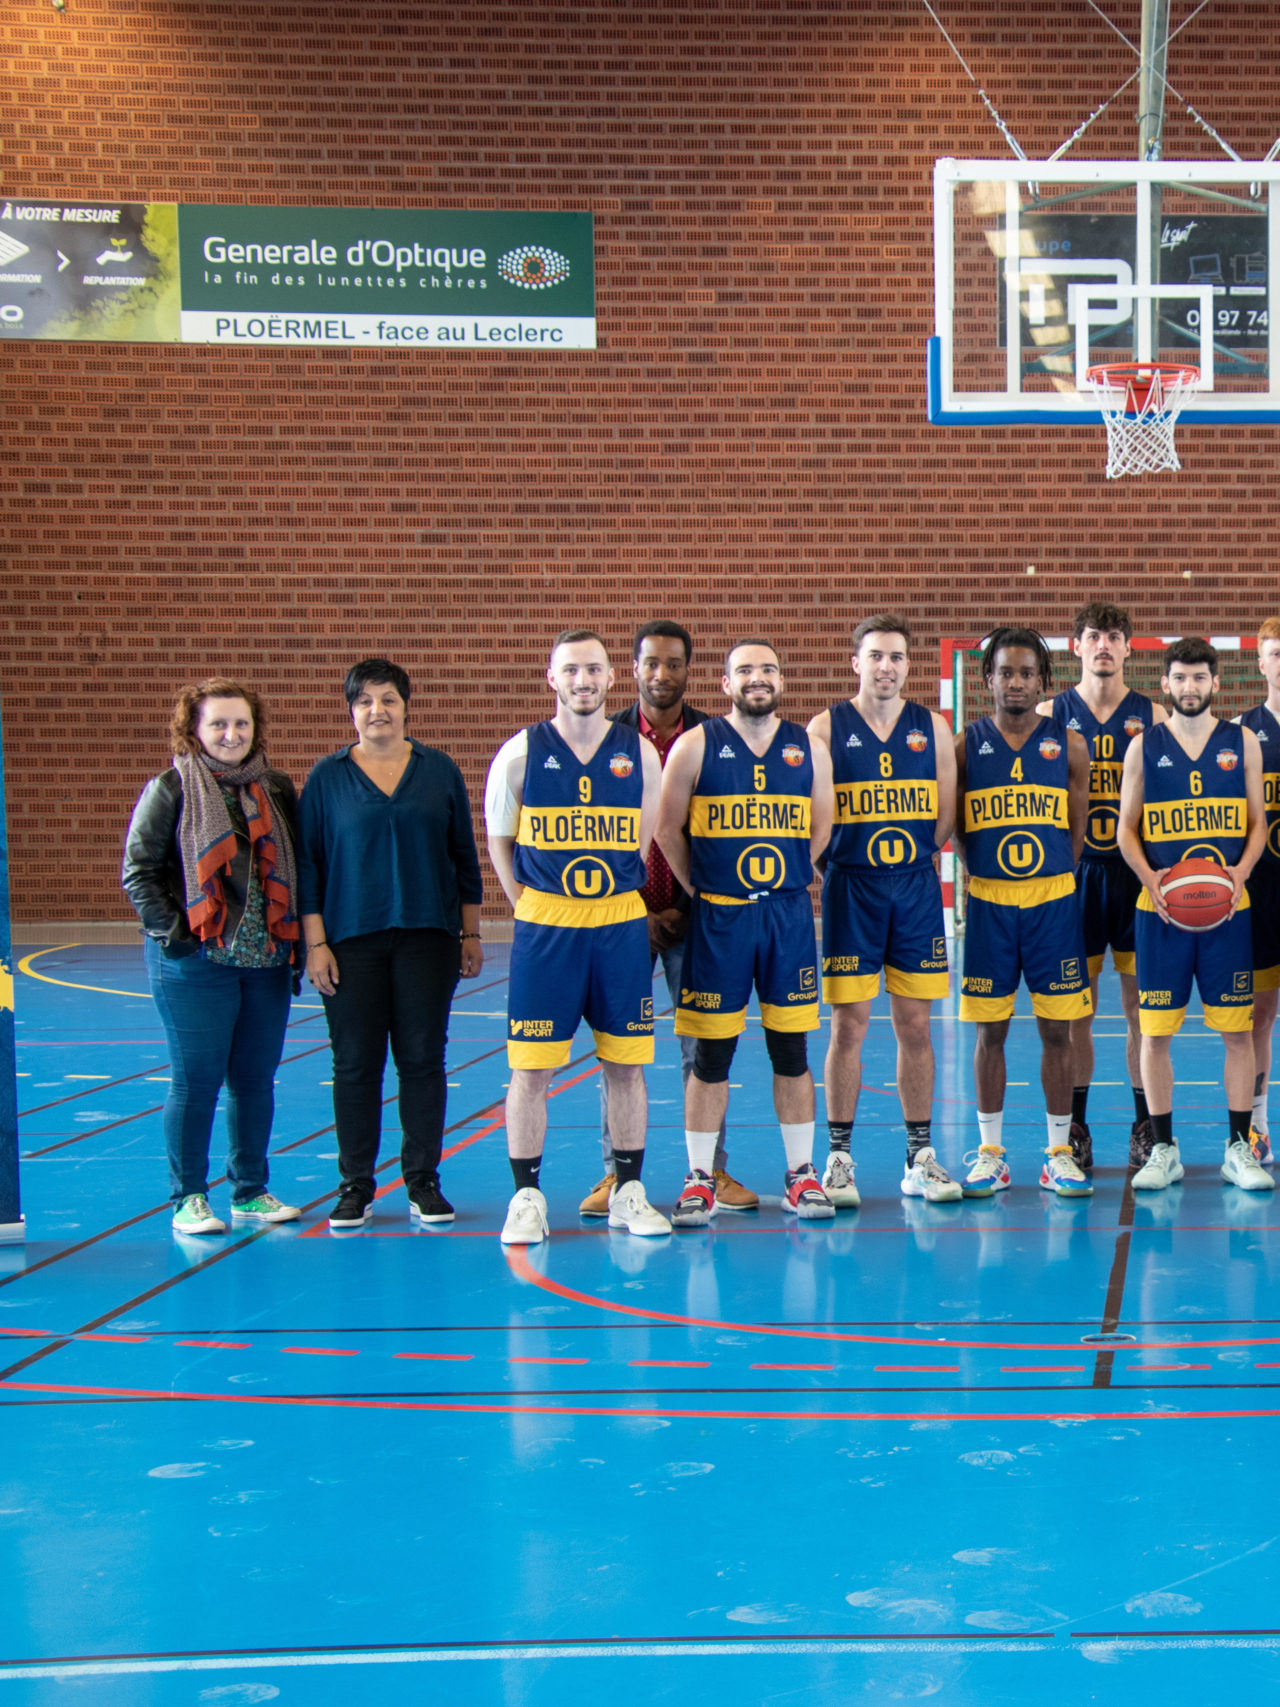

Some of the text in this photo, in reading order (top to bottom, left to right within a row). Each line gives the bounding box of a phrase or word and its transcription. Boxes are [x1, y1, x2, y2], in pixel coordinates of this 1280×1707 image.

[2, 203, 120, 223] À VOTRE MESURE
[203, 236, 337, 266] Generale
[0, 274, 41, 283] RMATION
[83, 275, 146, 286] REPLANTATION
[204, 271, 488, 289] la fin des lunettes chères
[1217, 310, 1240, 326] 97
[215, 314, 355, 340] PLOËRMEL
[377, 320, 429, 341] face
[437, 326, 465, 341] au
[474, 322, 563, 343] Leclerc
[1093, 734, 1114, 758] 10
[879, 752, 893, 778] 8
[1010, 757, 1024, 782] 4
[753, 764, 766, 791] 5
[1189, 770, 1203, 796] 6
[578, 775, 592, 804] 9
[836, 783, 933, 817] PLOËRMEL
[971, 788, 1062, 824] PLOËRMEL
[708, 798, 806, 831] PLOËRMEL
[1148, 803, 1242, 836] PLOËRMEL
[530, 810, 637, 844] PLOËRMEL
[831, 956, 859, 965] INTER
[831, 963, 858, 972] SPORT
[968, 977, 993, 986] INTER
[968, 983, 993, 993] SPORT
[1147, 990, 1172, 999] INTER
[1147, 997, 1172, 1006] SPORT
[523, 1019, 554, 1029] INTER
[523, 1027, 553, 1037] SPORT
[626, 1021, 654, 1031] Group
